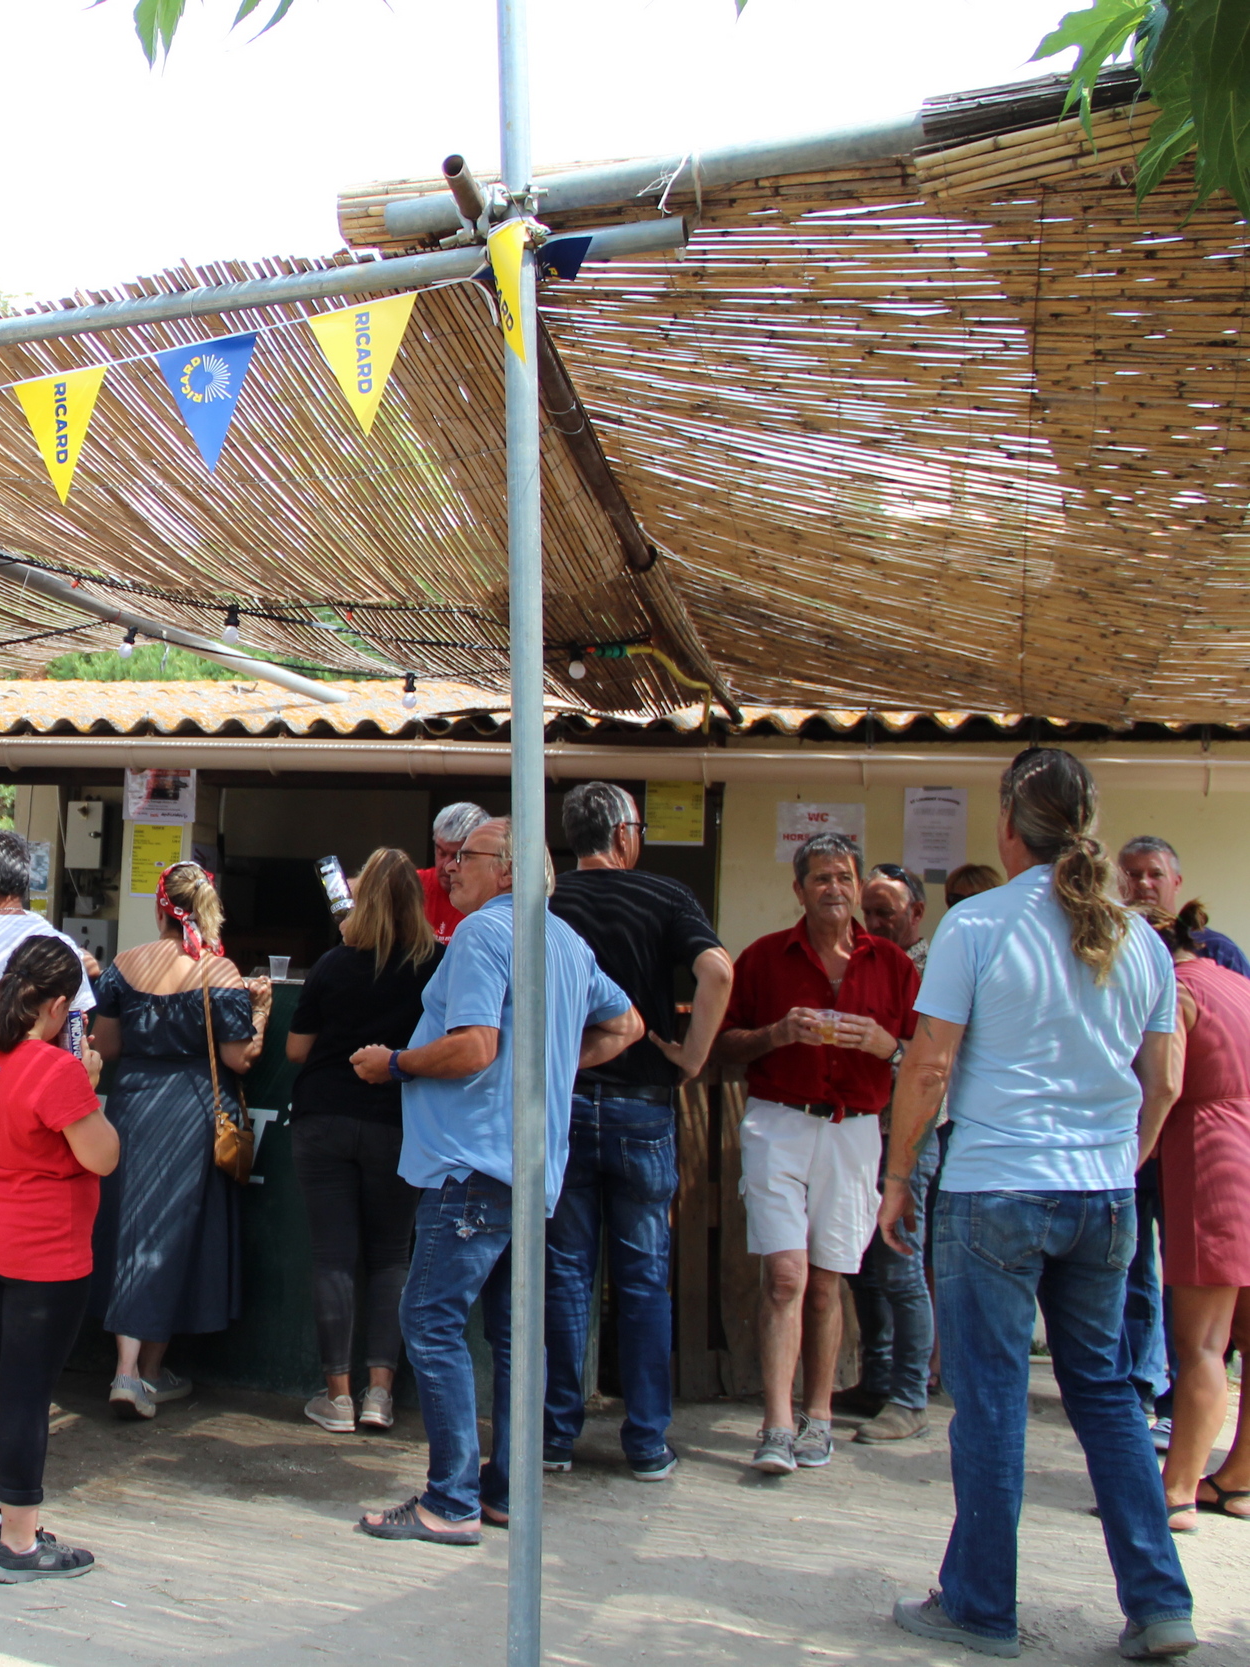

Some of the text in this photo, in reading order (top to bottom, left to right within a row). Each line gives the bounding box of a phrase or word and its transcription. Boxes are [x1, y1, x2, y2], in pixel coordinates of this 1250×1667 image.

[180, 356, 203, 403] RICARD
[355, 311, 373, 394] RICARD
[54, 382, 68, 464] RICARD
[807, 812, 829, 822] WC
